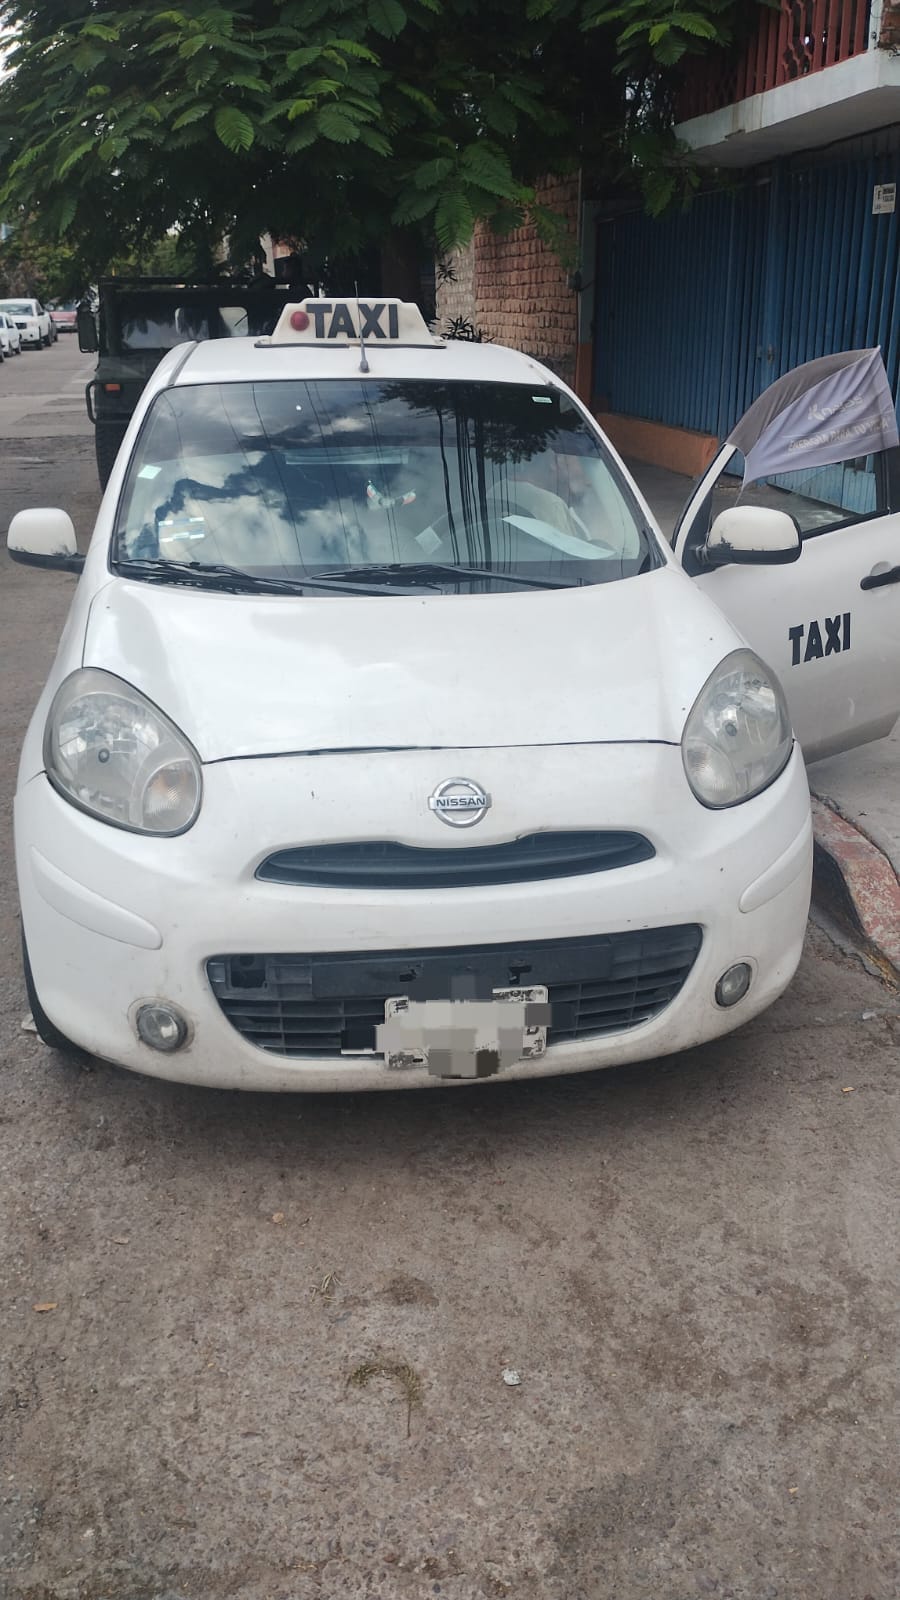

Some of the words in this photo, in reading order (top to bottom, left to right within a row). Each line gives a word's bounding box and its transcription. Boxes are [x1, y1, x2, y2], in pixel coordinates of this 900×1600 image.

[306, 303, 399, 339] TAXI
[788, 611, 851, 667] TAXI
[436, 797, 486, 807] NISSAN
